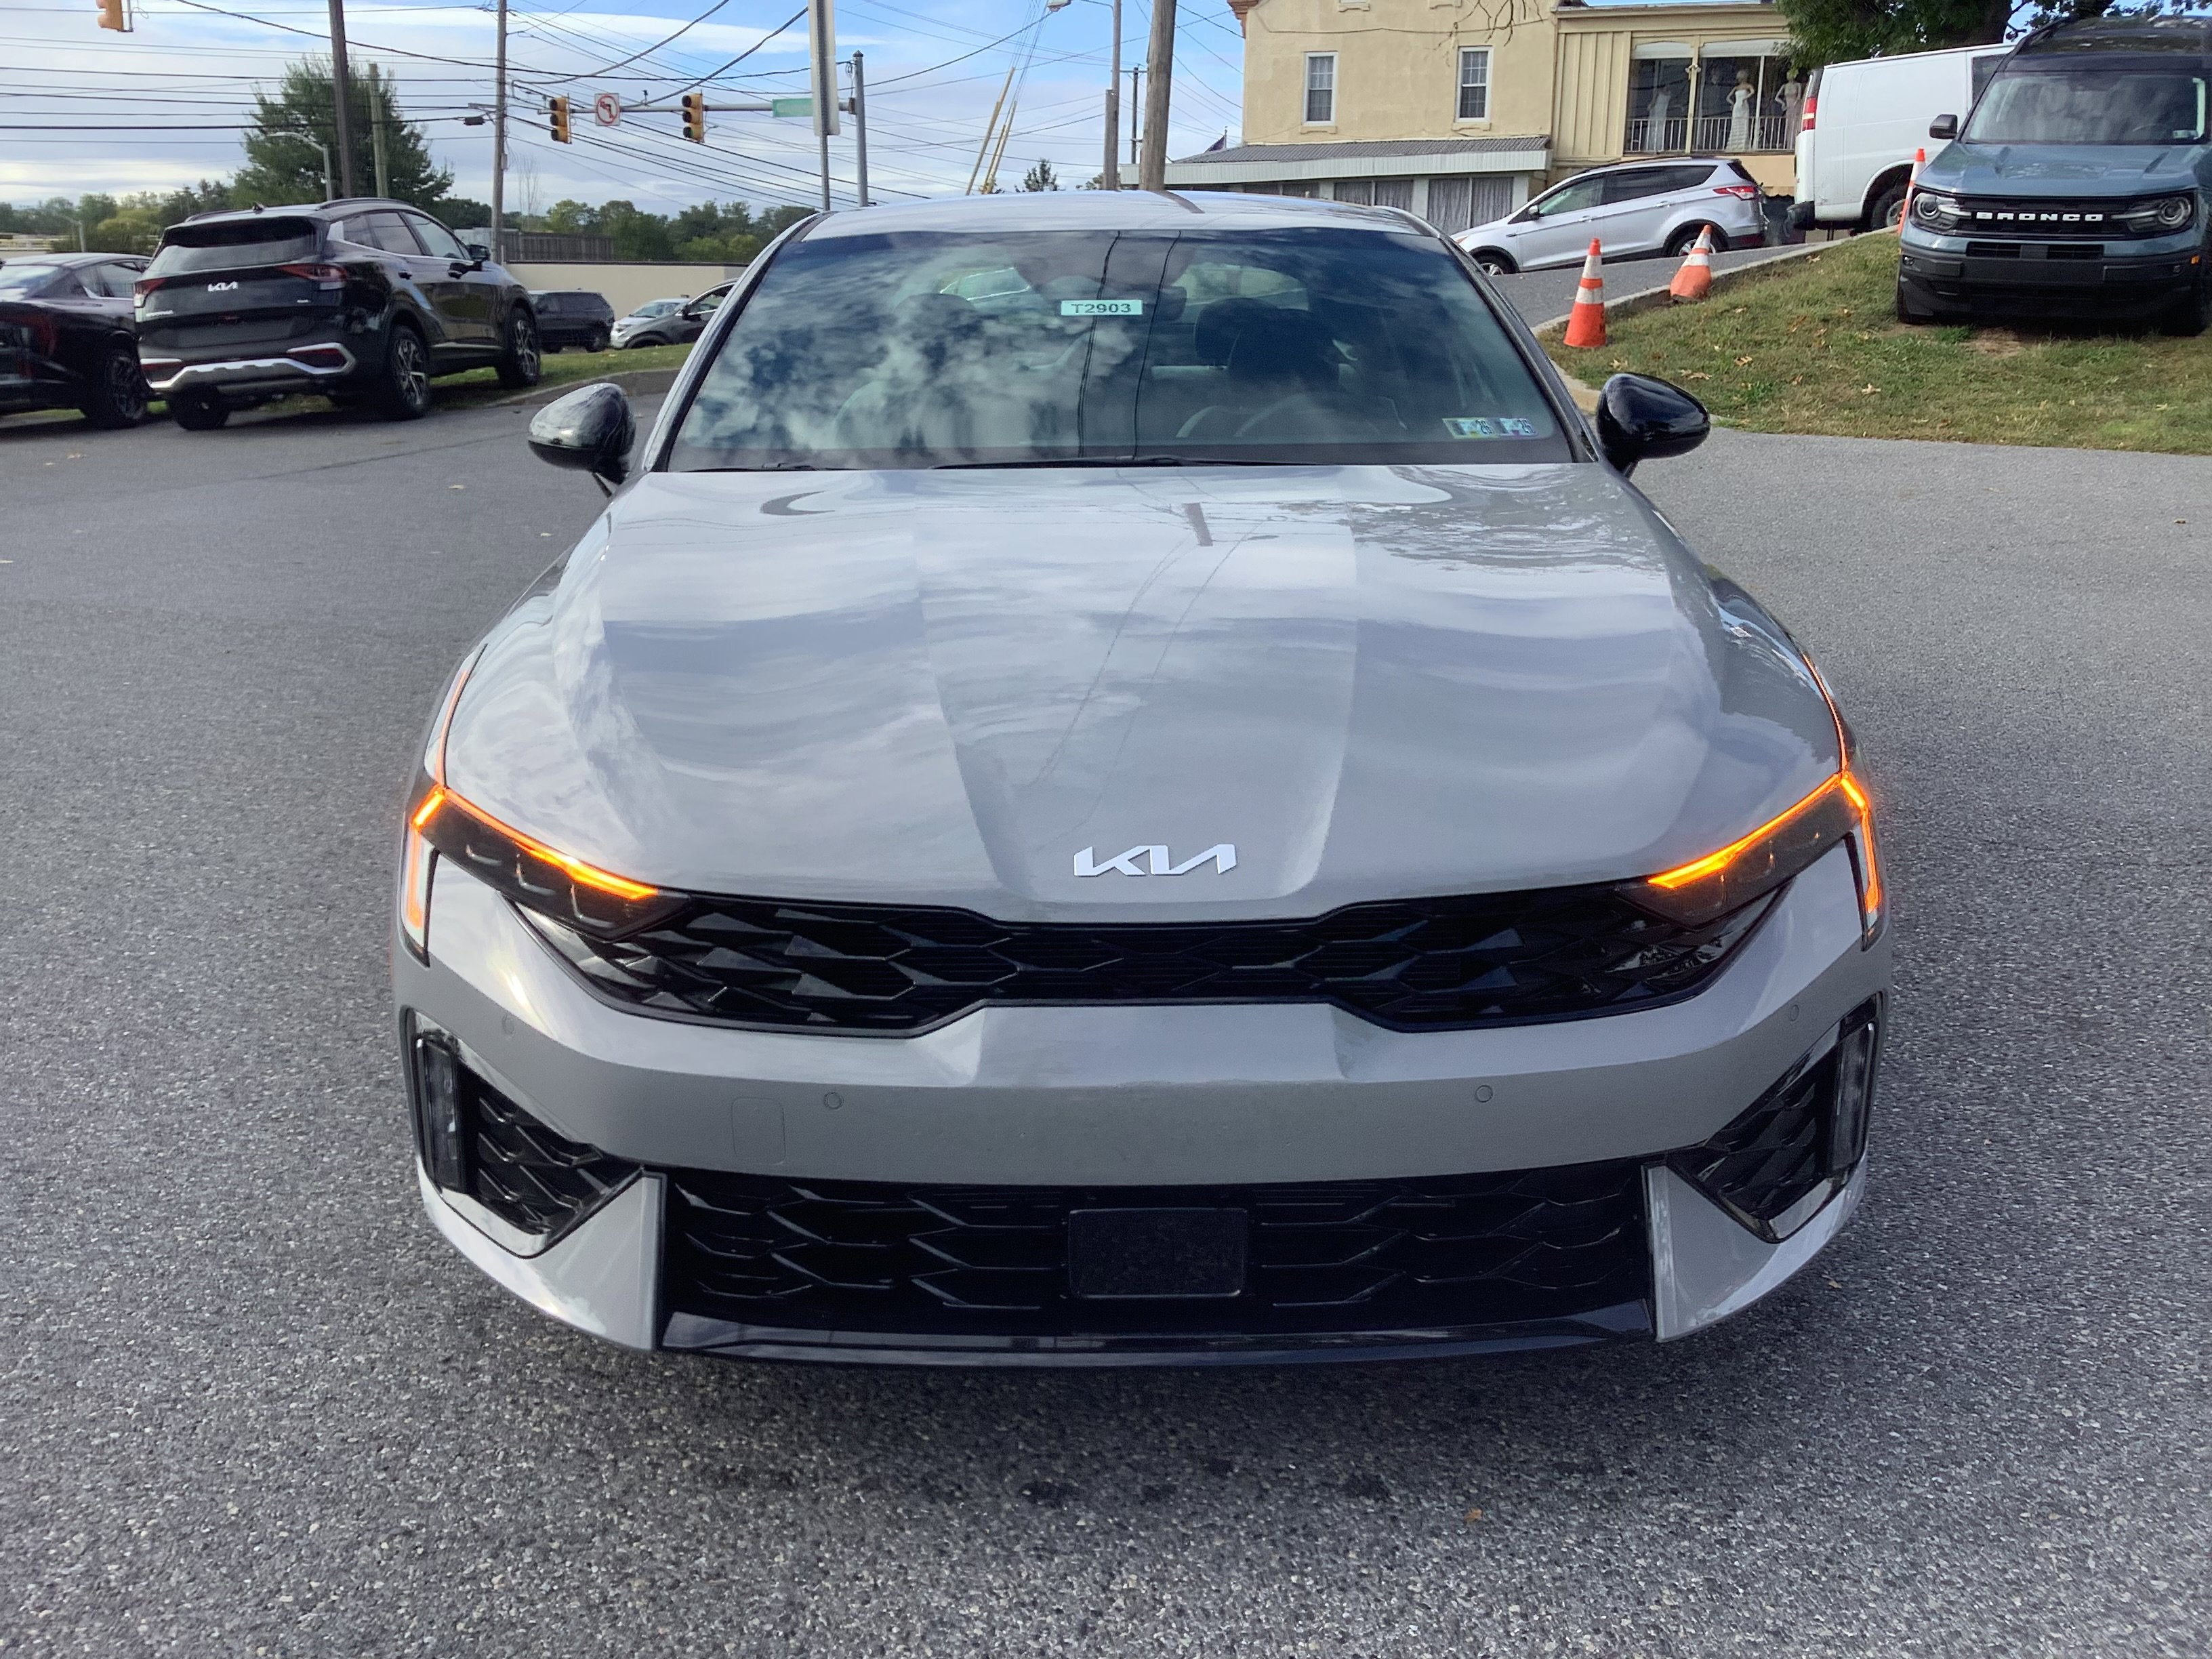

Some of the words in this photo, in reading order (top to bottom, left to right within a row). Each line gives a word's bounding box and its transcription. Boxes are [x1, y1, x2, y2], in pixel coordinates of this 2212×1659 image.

[1976, 211, 2103, 221] BRONCO
[207, 281, 238, 291] KIA
[1071, 303, 1131, 313] T2903
[1074, 844, 1237, 876] KIA
